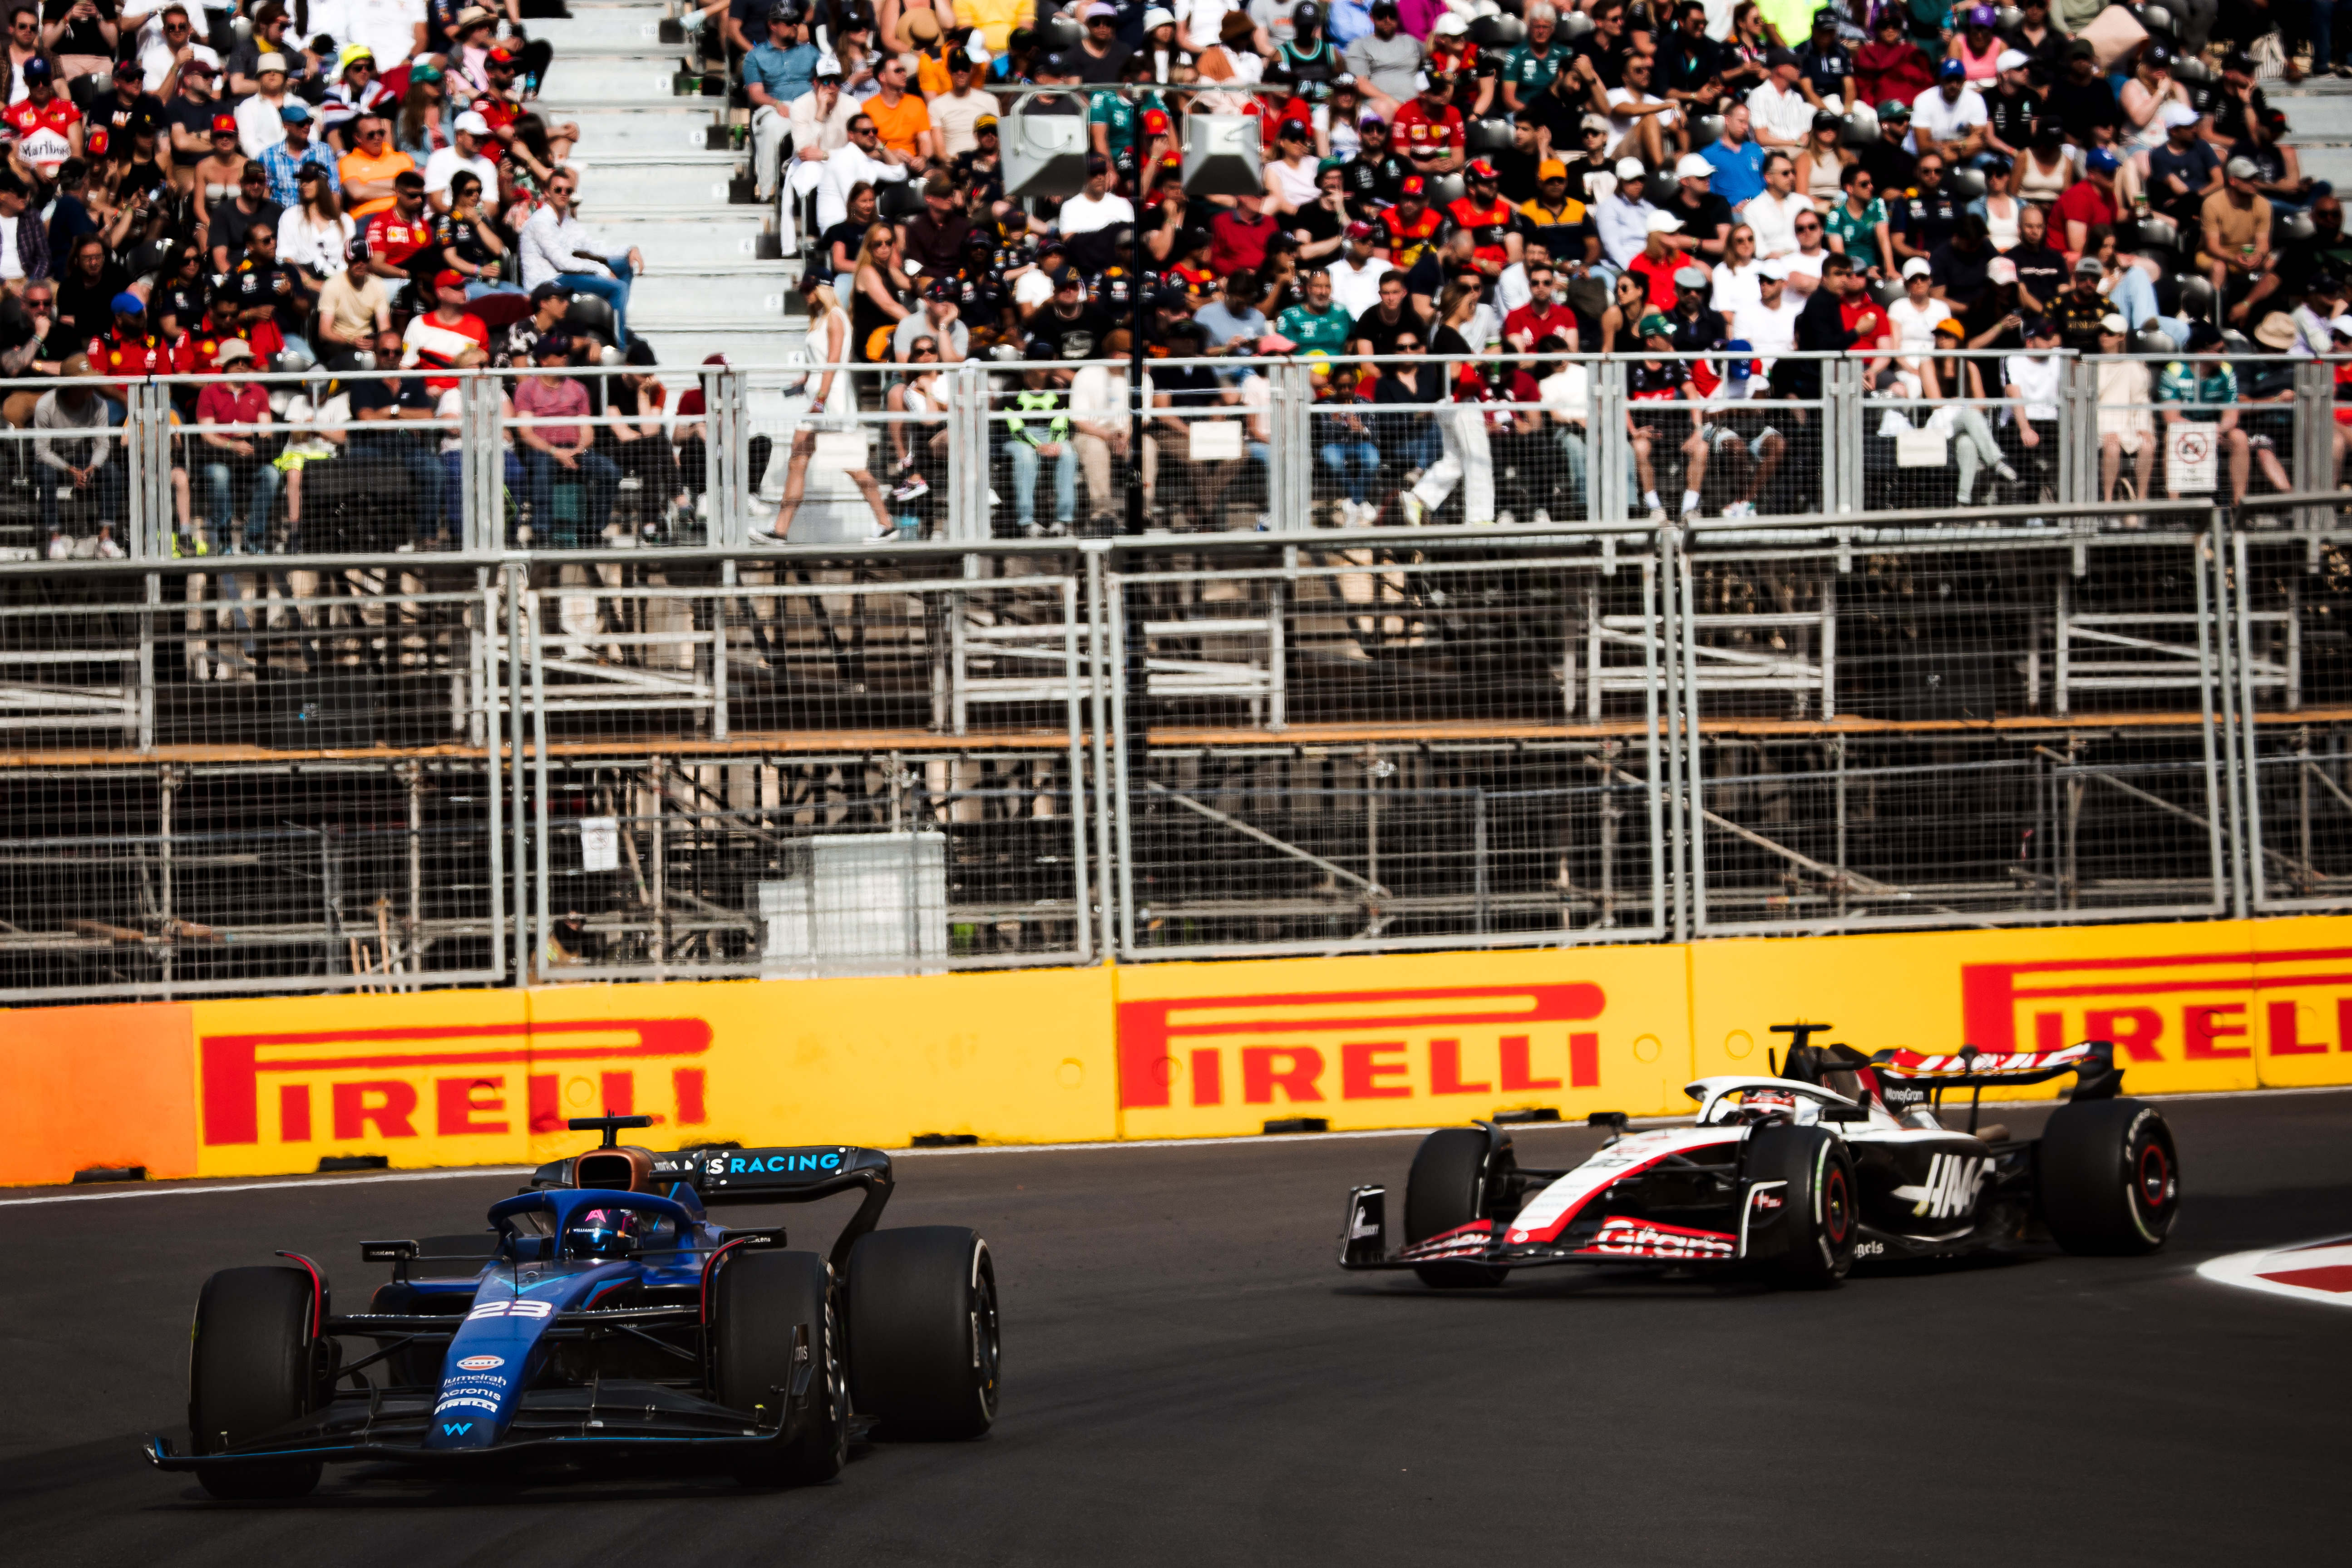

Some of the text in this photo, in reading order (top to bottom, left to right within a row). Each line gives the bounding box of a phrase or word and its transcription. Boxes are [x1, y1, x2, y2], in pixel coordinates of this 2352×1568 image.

[1961, 948, 2352, 1062] PIREL
[1117, 981, 1606, 1109] PIRELLI
[201, 1017, 714, 1145] PIRELLI
[1885, 1087, 1923, 1104] MoneyGram
[730, 1154, 840, 1174] RACING
[1597, 1220, 1734, 1258] Gram
[1854, 1241, 1884, 1258] gels
[466, 1300, 553, 1321] 23
[443, 1374, 507, 1388] Jumeirah
[438, 1388, 501, 1403] Acronis
[434, 1397, 498, 1415] PIRELLI
